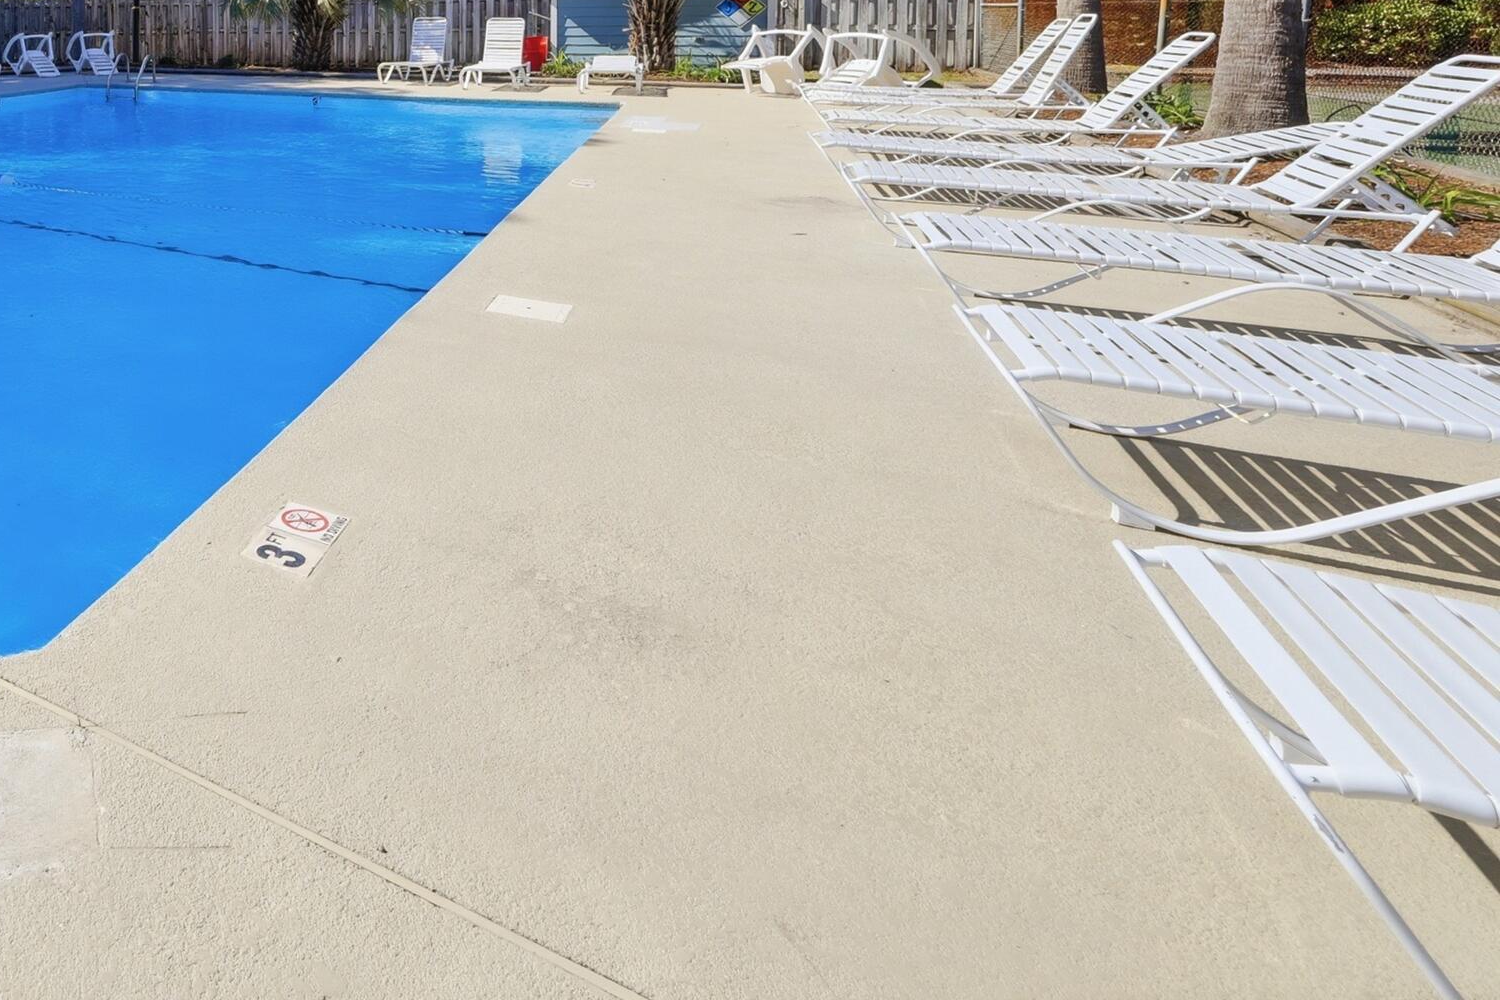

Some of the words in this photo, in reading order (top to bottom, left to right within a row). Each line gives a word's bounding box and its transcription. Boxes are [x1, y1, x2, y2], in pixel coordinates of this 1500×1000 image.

[749, 2, 757, 13] 2
[266, 532, 287, 545] FT
[256, 544, 306, 568] 3
